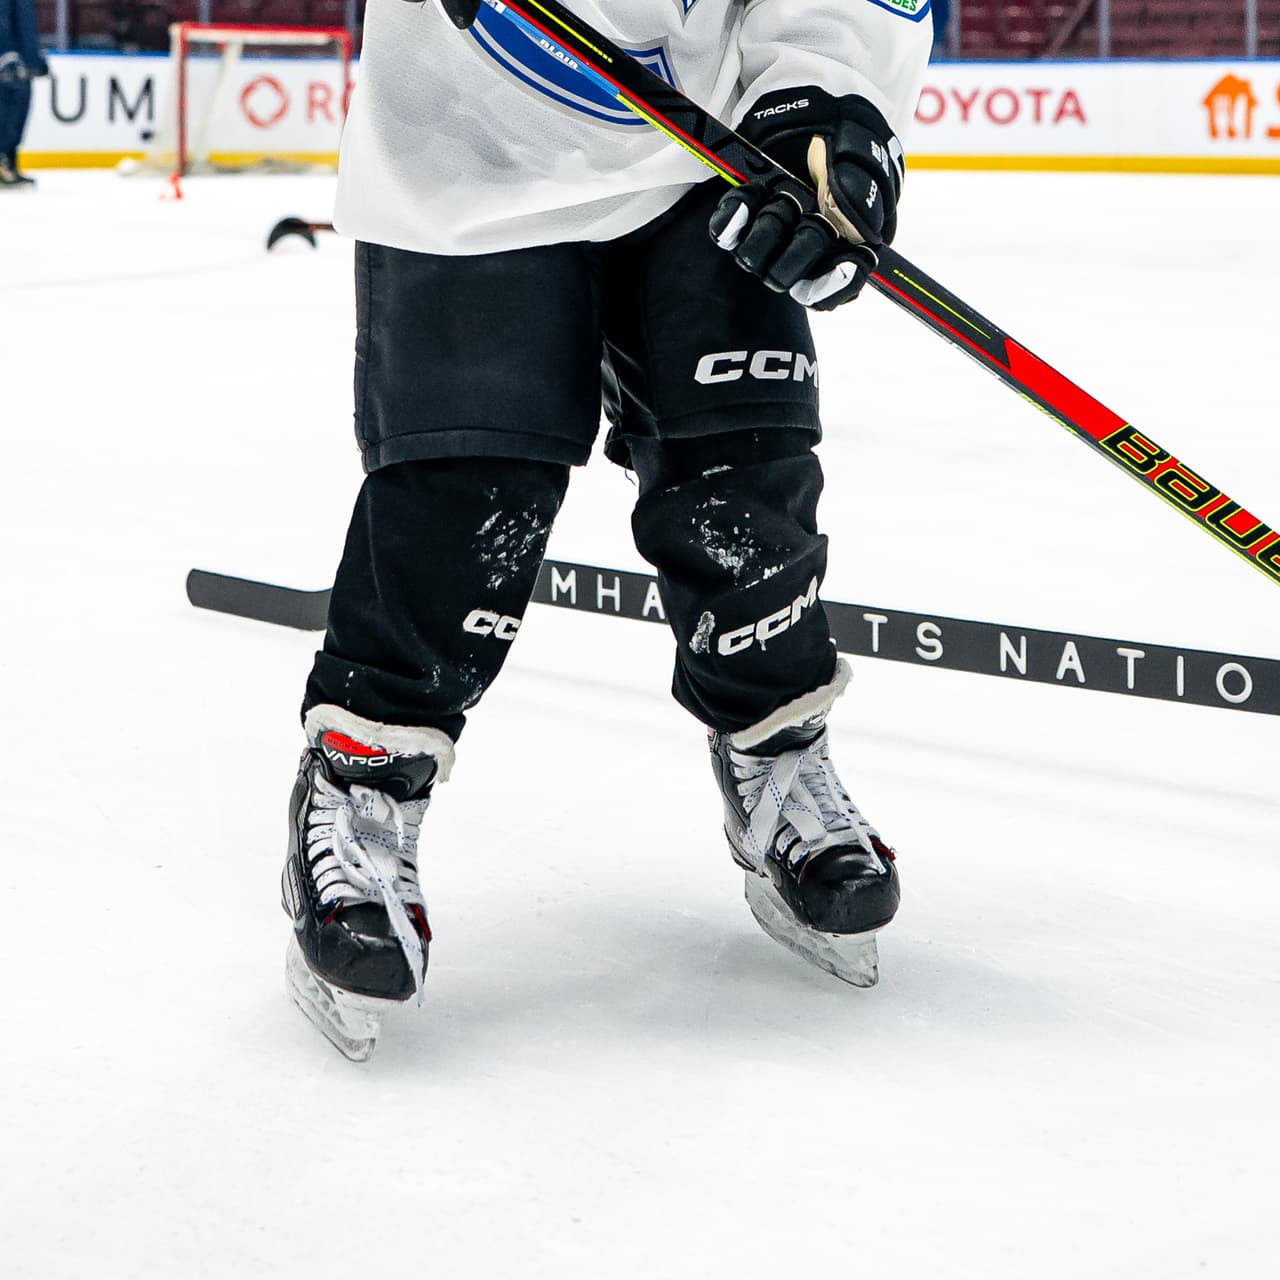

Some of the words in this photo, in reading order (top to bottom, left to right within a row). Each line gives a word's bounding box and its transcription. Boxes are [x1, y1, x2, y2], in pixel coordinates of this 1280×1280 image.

[753, 98, 810, 120] TACKS
[693, 350, 819, 388] CCM
[717, 573, 820, 656] CCM
